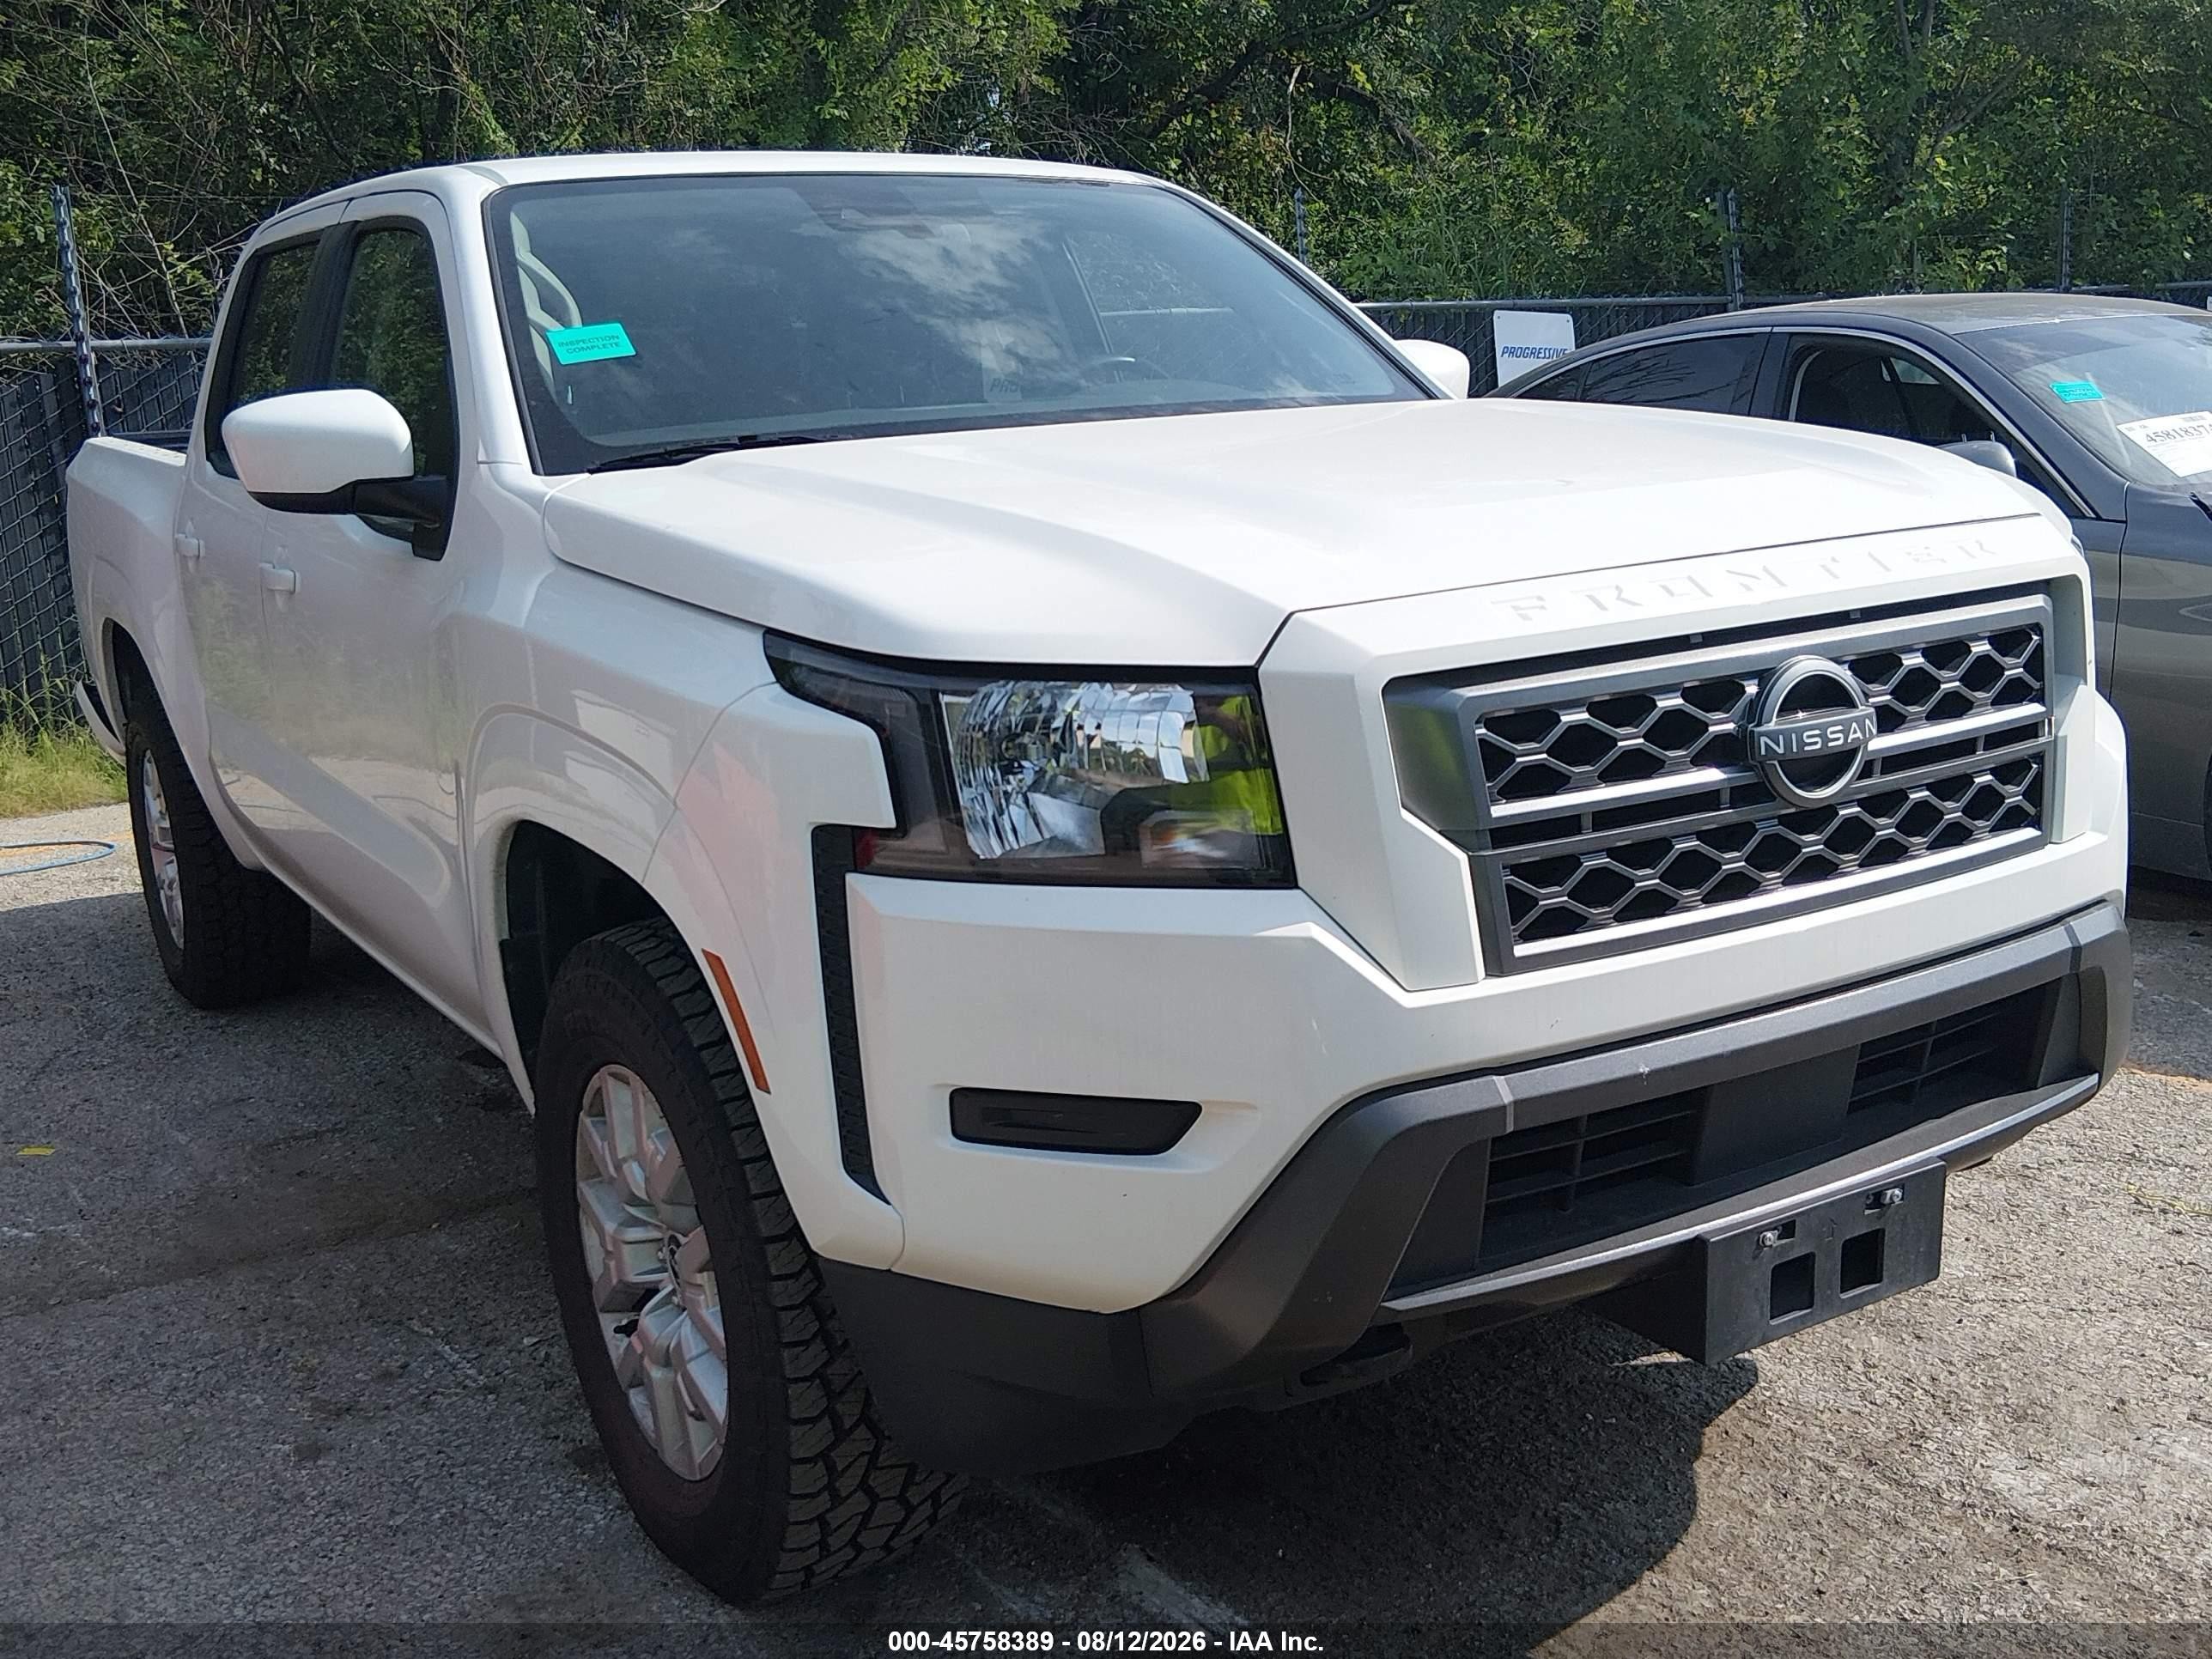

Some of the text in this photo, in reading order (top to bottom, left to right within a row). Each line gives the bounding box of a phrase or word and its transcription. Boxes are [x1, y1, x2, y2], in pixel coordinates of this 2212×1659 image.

[558, 334, 619, 348] INSPECTION
[567, 342, 619, 355] COMPLETE
[1491, 539, 1998, 622] FRONTIER
[1760, 714, 1876, 757] NISSAN
